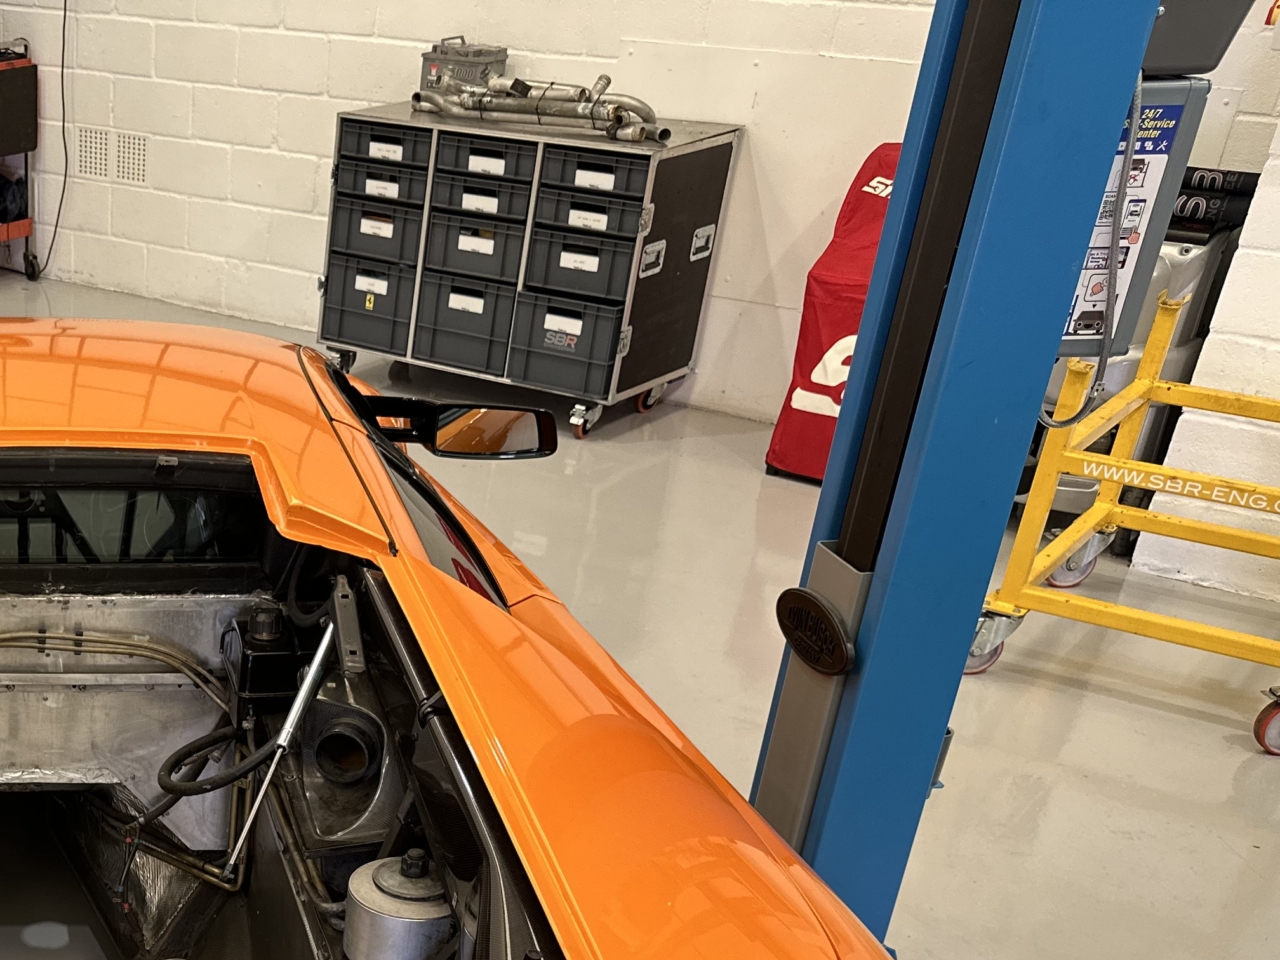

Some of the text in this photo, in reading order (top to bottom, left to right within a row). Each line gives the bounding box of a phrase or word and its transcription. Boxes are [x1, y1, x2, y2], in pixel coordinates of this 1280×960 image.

[1141, 109, 1163, 119] 24/7
[1136, 130, 1161, 138] enter
[544, 331, 577, 348] SBR
